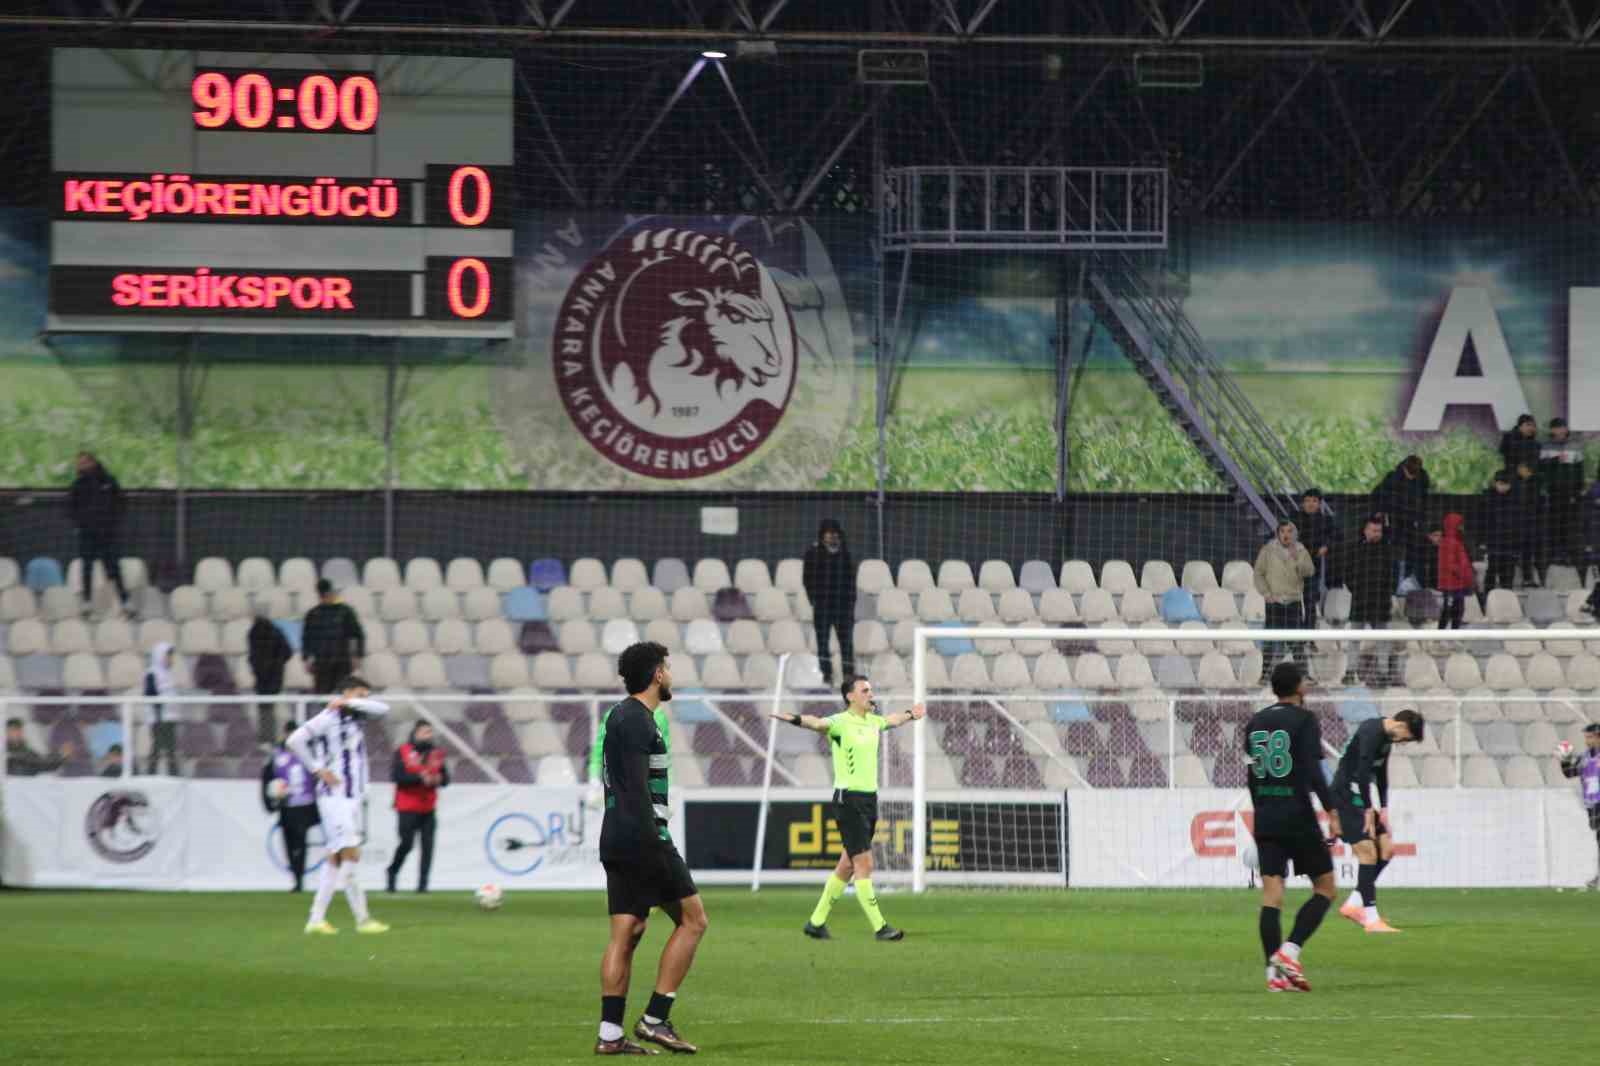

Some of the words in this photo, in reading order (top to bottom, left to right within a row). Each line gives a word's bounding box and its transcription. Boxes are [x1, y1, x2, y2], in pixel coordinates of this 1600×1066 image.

[192, 72, 379, 131] 90:00
[63, 174, 399, 220] KEÇİÖRENGÜCÜ
[448, 165, 492, 226] 0
[112, 267, 354, 310] SERİKSPOR
[448, 257, 491, 318] 0
[1249, 729, 1293, 779] 58
